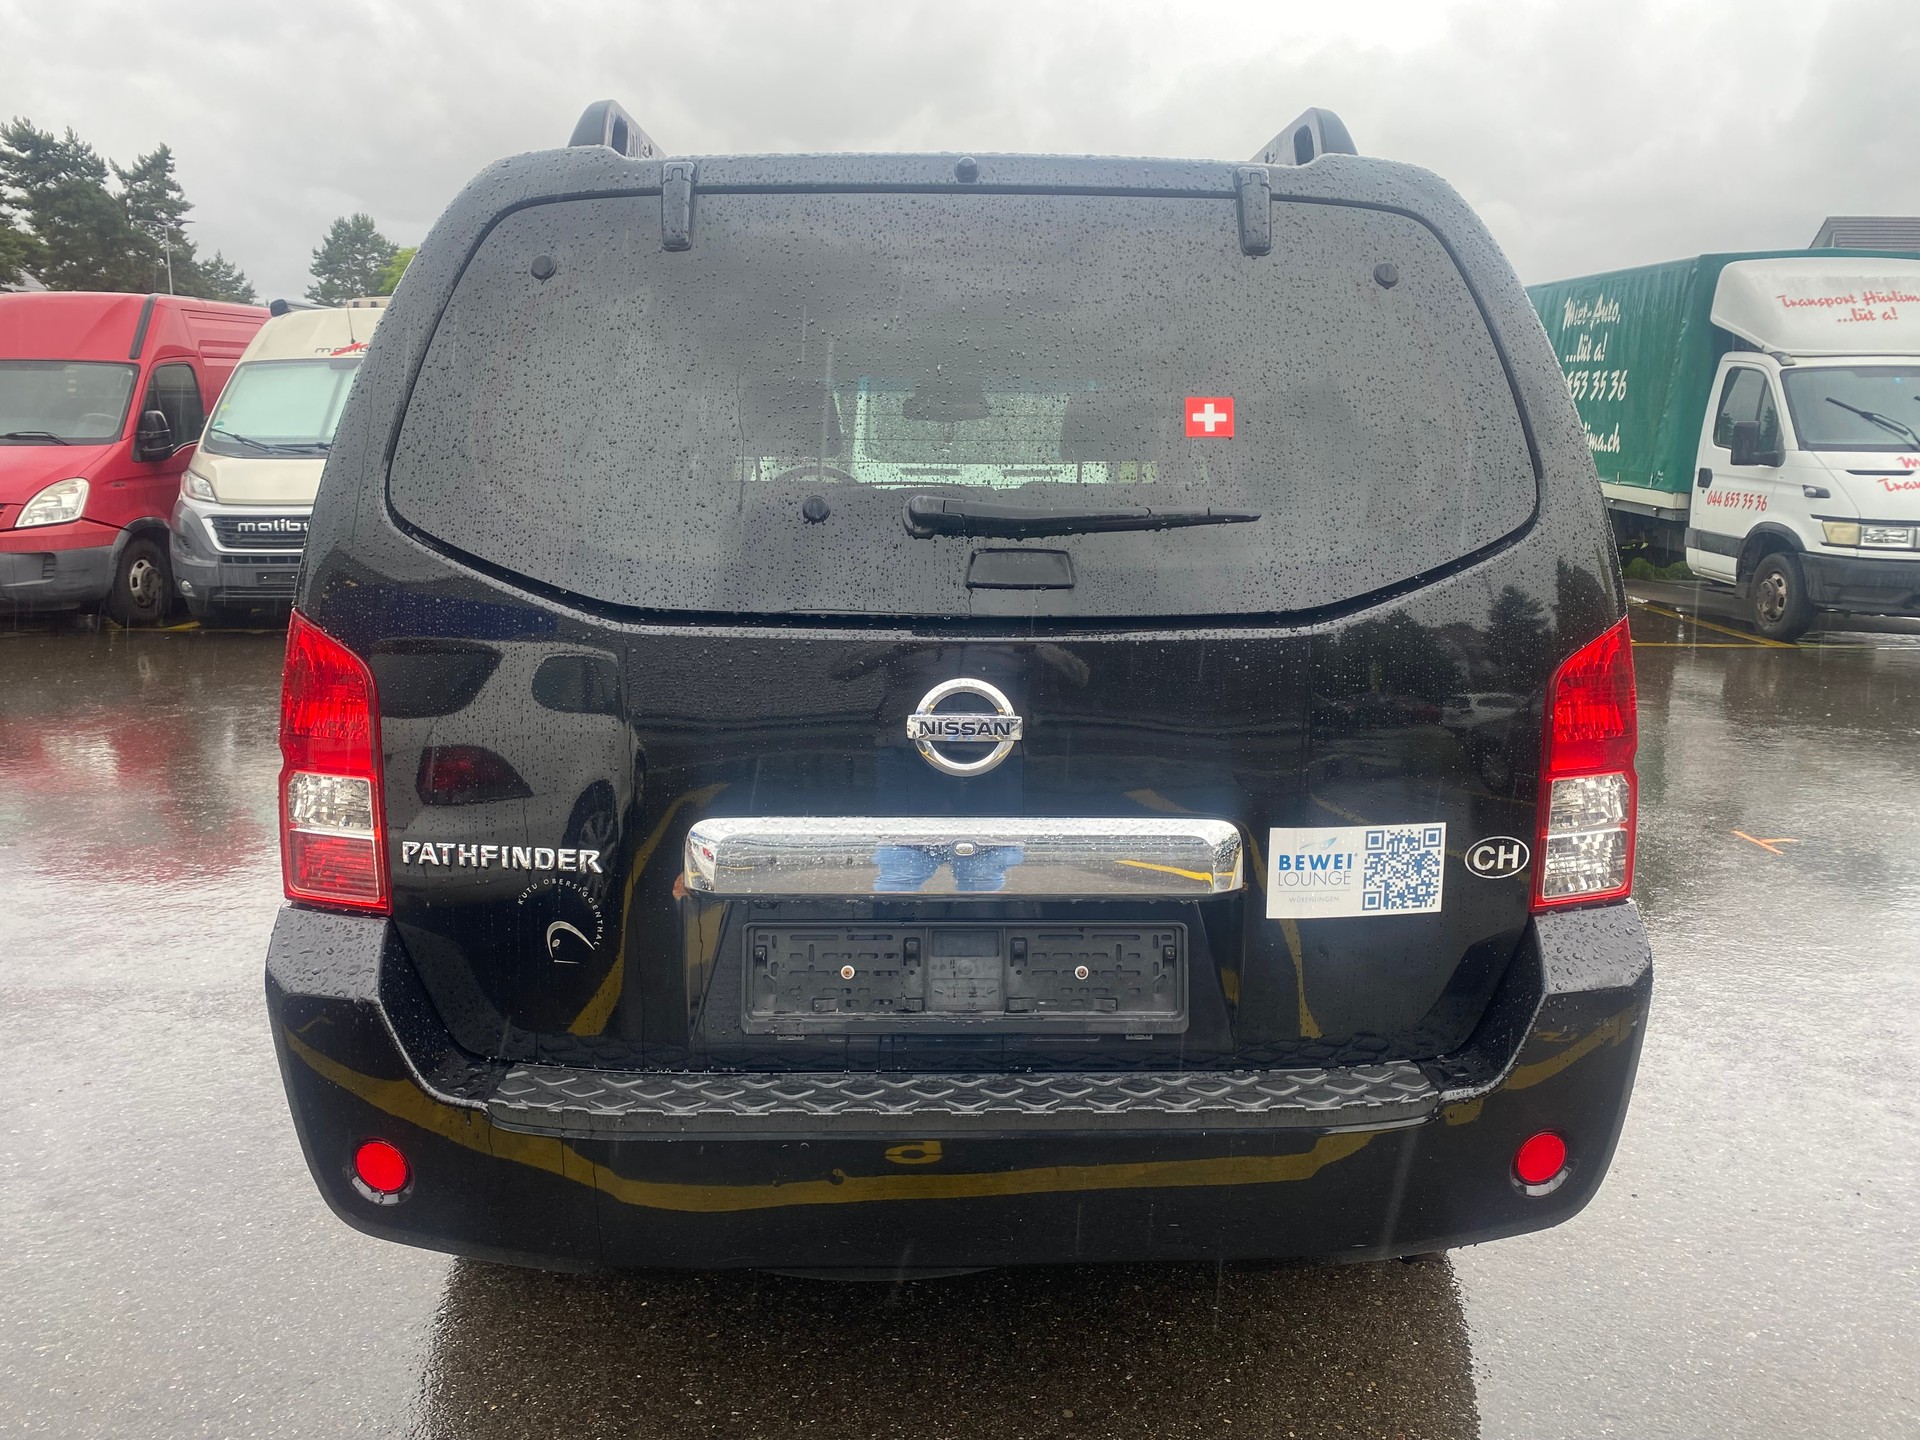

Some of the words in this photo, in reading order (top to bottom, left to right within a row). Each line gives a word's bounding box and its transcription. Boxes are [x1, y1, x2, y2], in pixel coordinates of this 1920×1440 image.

[1776, 294, 1857, 308] Transport
[1881, 306, 1899, 321] a!
[1593, 332, 1608, 361] a!
[1589, 370, 1608, 401] 35
[1608, 369, 1628, 401] 36
[1707, 490, 1722, 507] 044
[1723, 492, 1741, 508] 853
[1741, 493, 1755, 510] 35
[1755, 494, 1768, 512] 36
[919, 720, 1011, 736] NISSAN
[401, 840, 604, 874] PATHFINDER
[1278, 853, 1353, 871] BEWEI
[1472, 845, 1520, 870] CH
[1278, 870, 1352, 887] LOUNGE
[517, 883, 538, 906] KUTU
[543, 877, 605, 947] OBERSIGGENTHAL
